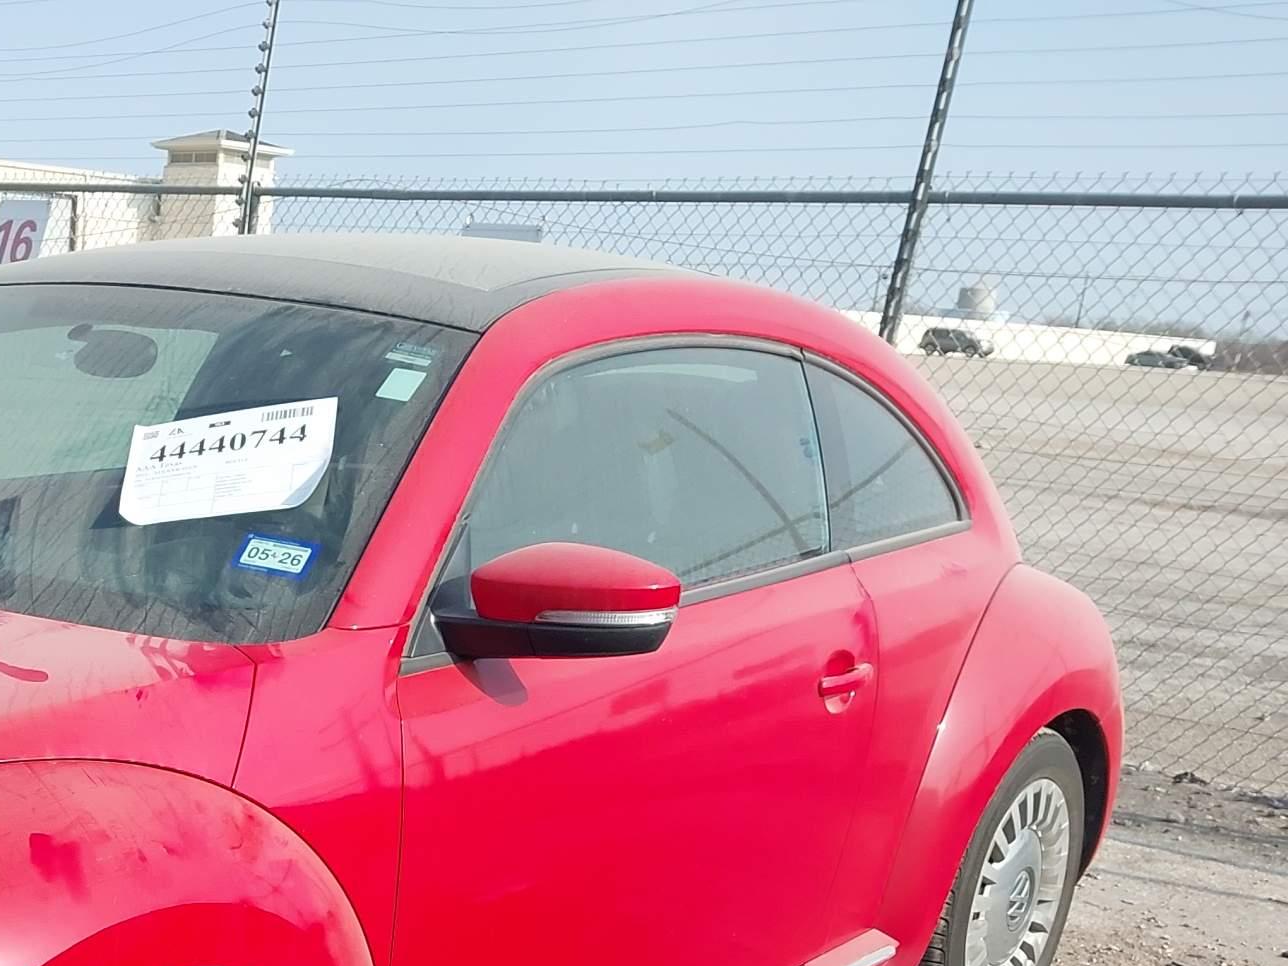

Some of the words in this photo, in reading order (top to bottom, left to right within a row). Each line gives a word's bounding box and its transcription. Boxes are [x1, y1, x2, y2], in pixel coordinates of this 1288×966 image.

[149, 423, 307, 462] 44440744
[247, 546, 272, 561] 05
[278, 552, 303, 567] 26
